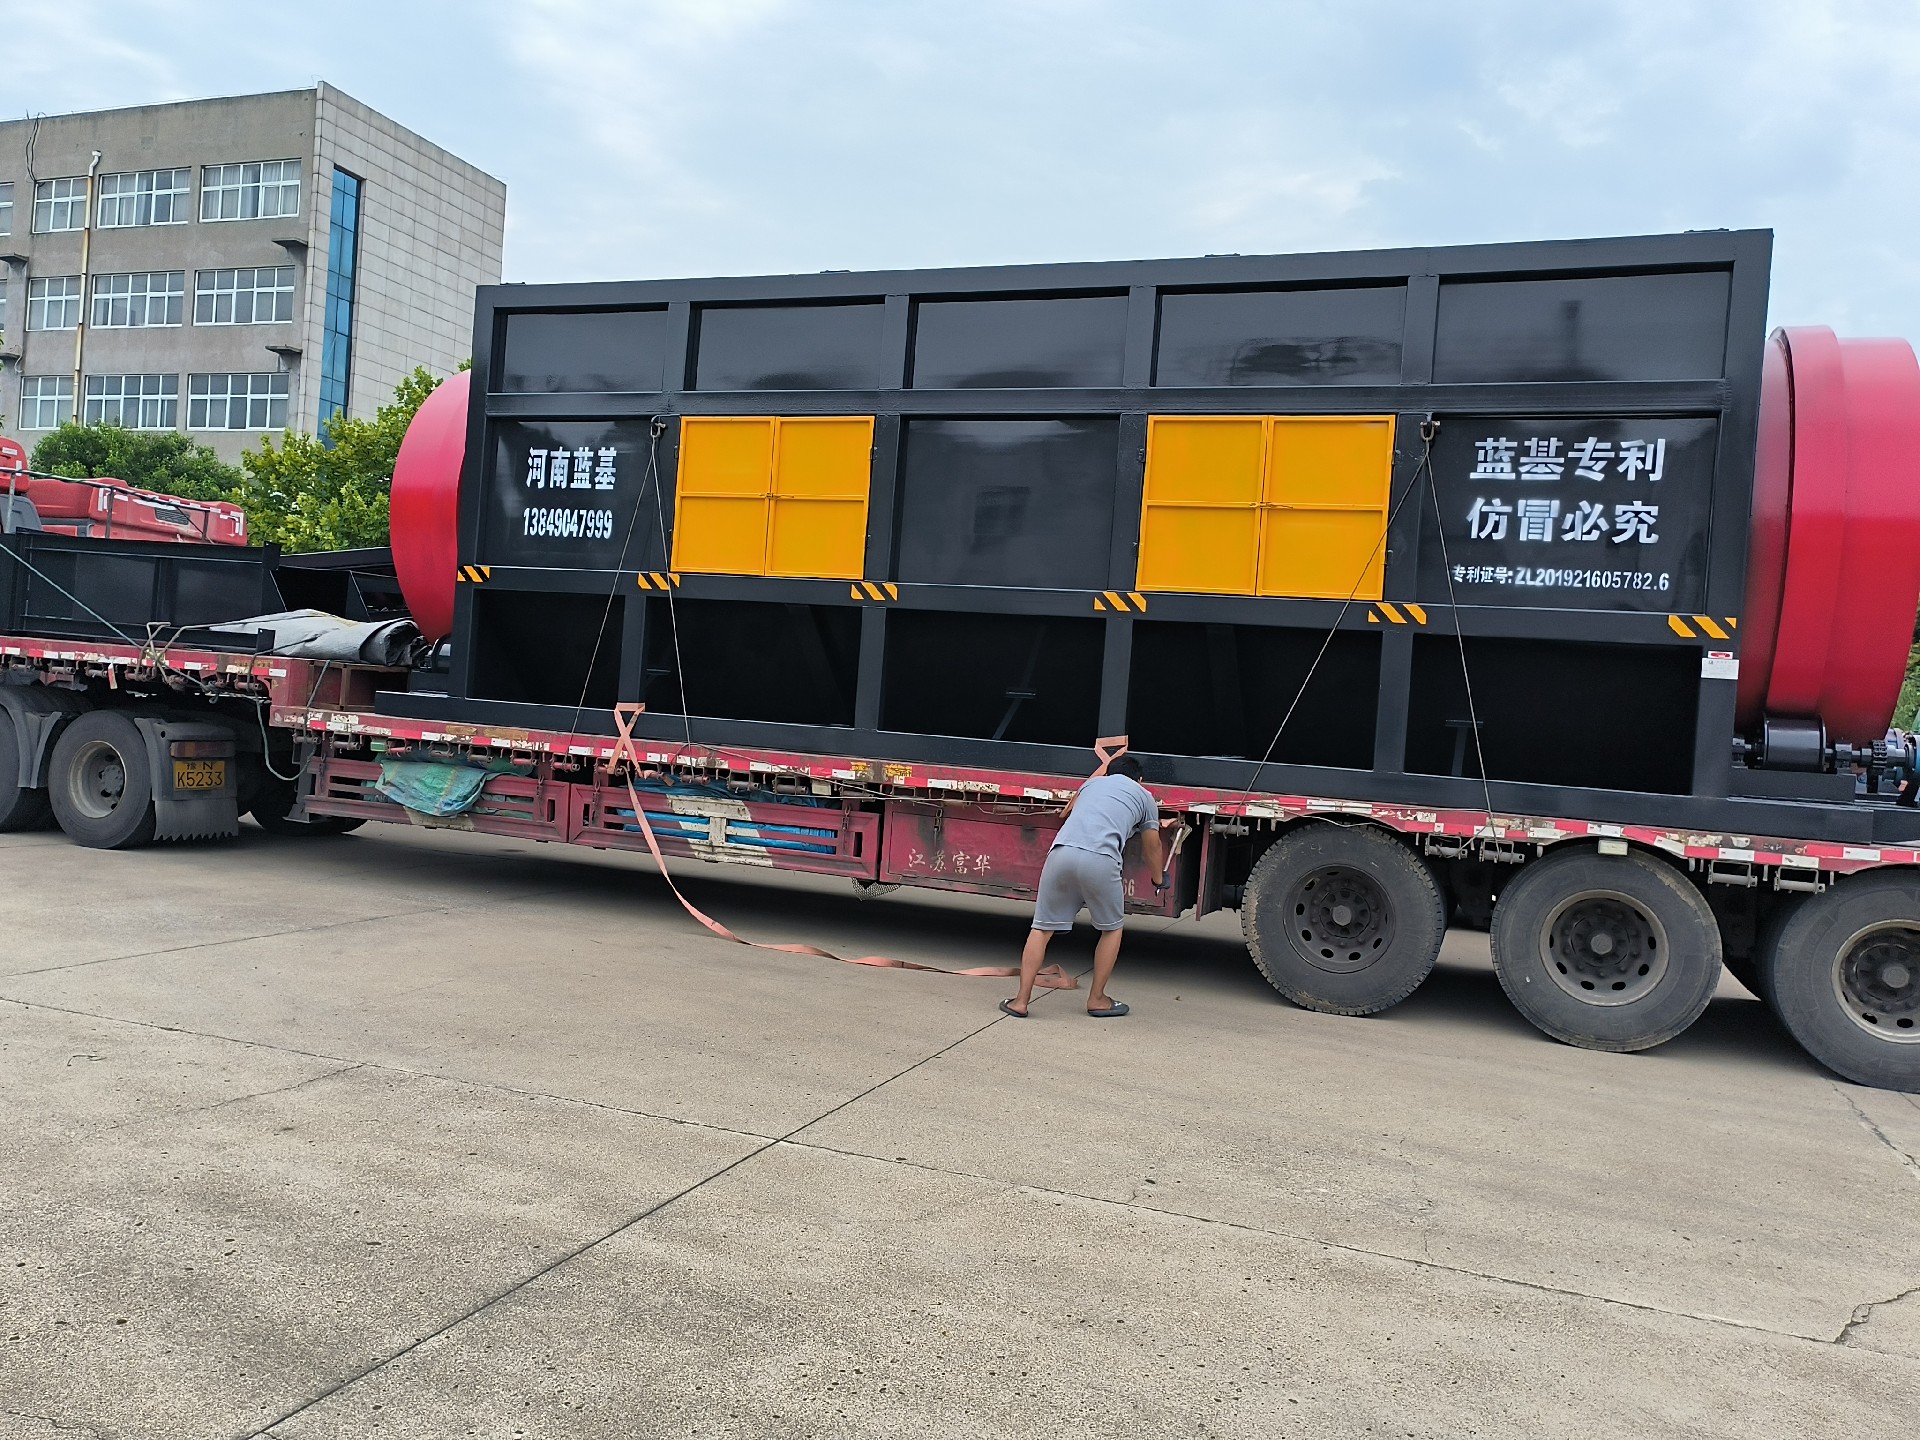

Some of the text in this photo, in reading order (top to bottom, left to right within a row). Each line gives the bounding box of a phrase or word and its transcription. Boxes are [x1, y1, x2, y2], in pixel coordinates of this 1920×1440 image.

[525, 446, 618, 490] 河南蓝基
[1469, 436, 1666, 482] 蓝基专利
[523, 507, 613, 540] 13849047999
[1466, 497, 1659, 544] 仿冒必究
[177, 771, 223, 787] K5233
[908, 848, 992, 877] 江苏富华
